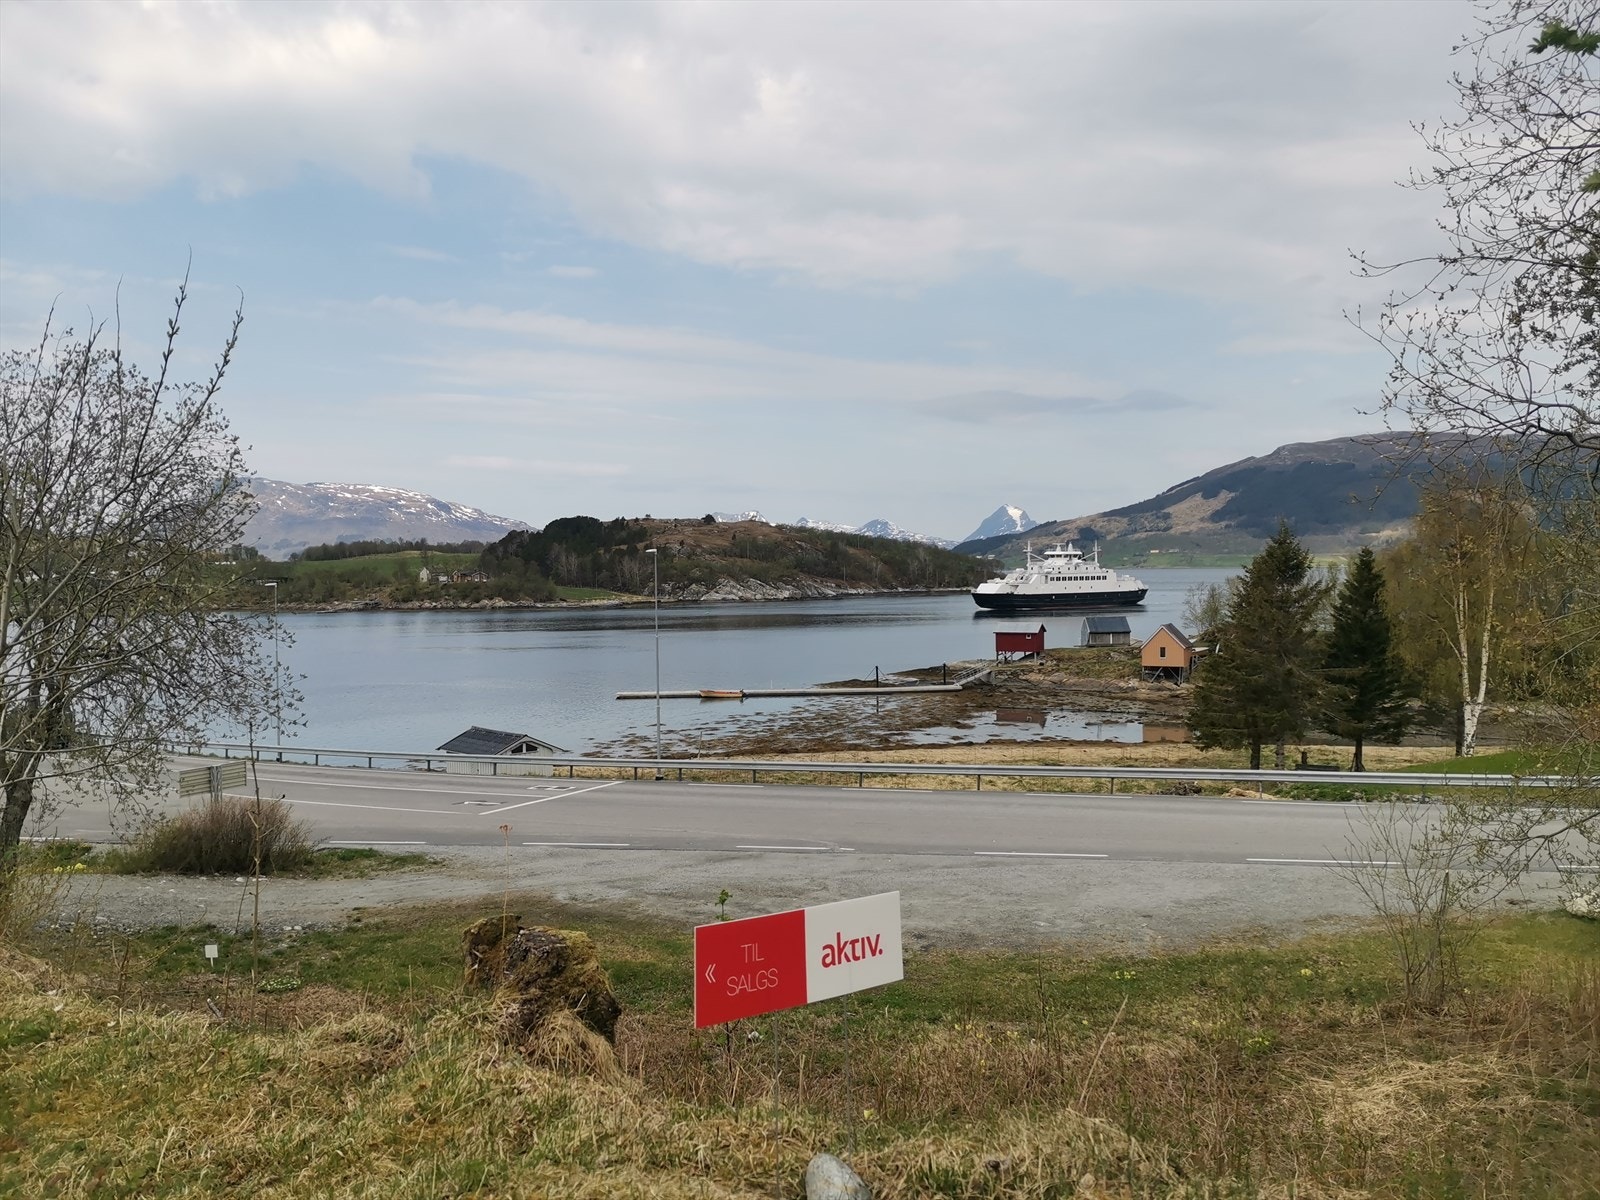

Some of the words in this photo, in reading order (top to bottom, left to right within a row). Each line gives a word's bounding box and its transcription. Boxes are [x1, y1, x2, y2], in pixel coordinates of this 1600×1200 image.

[740, 942, 765, 963] TIL
[821, 932, 883, 968] aktiv.
[726, 968, 779, 996] SALGS
